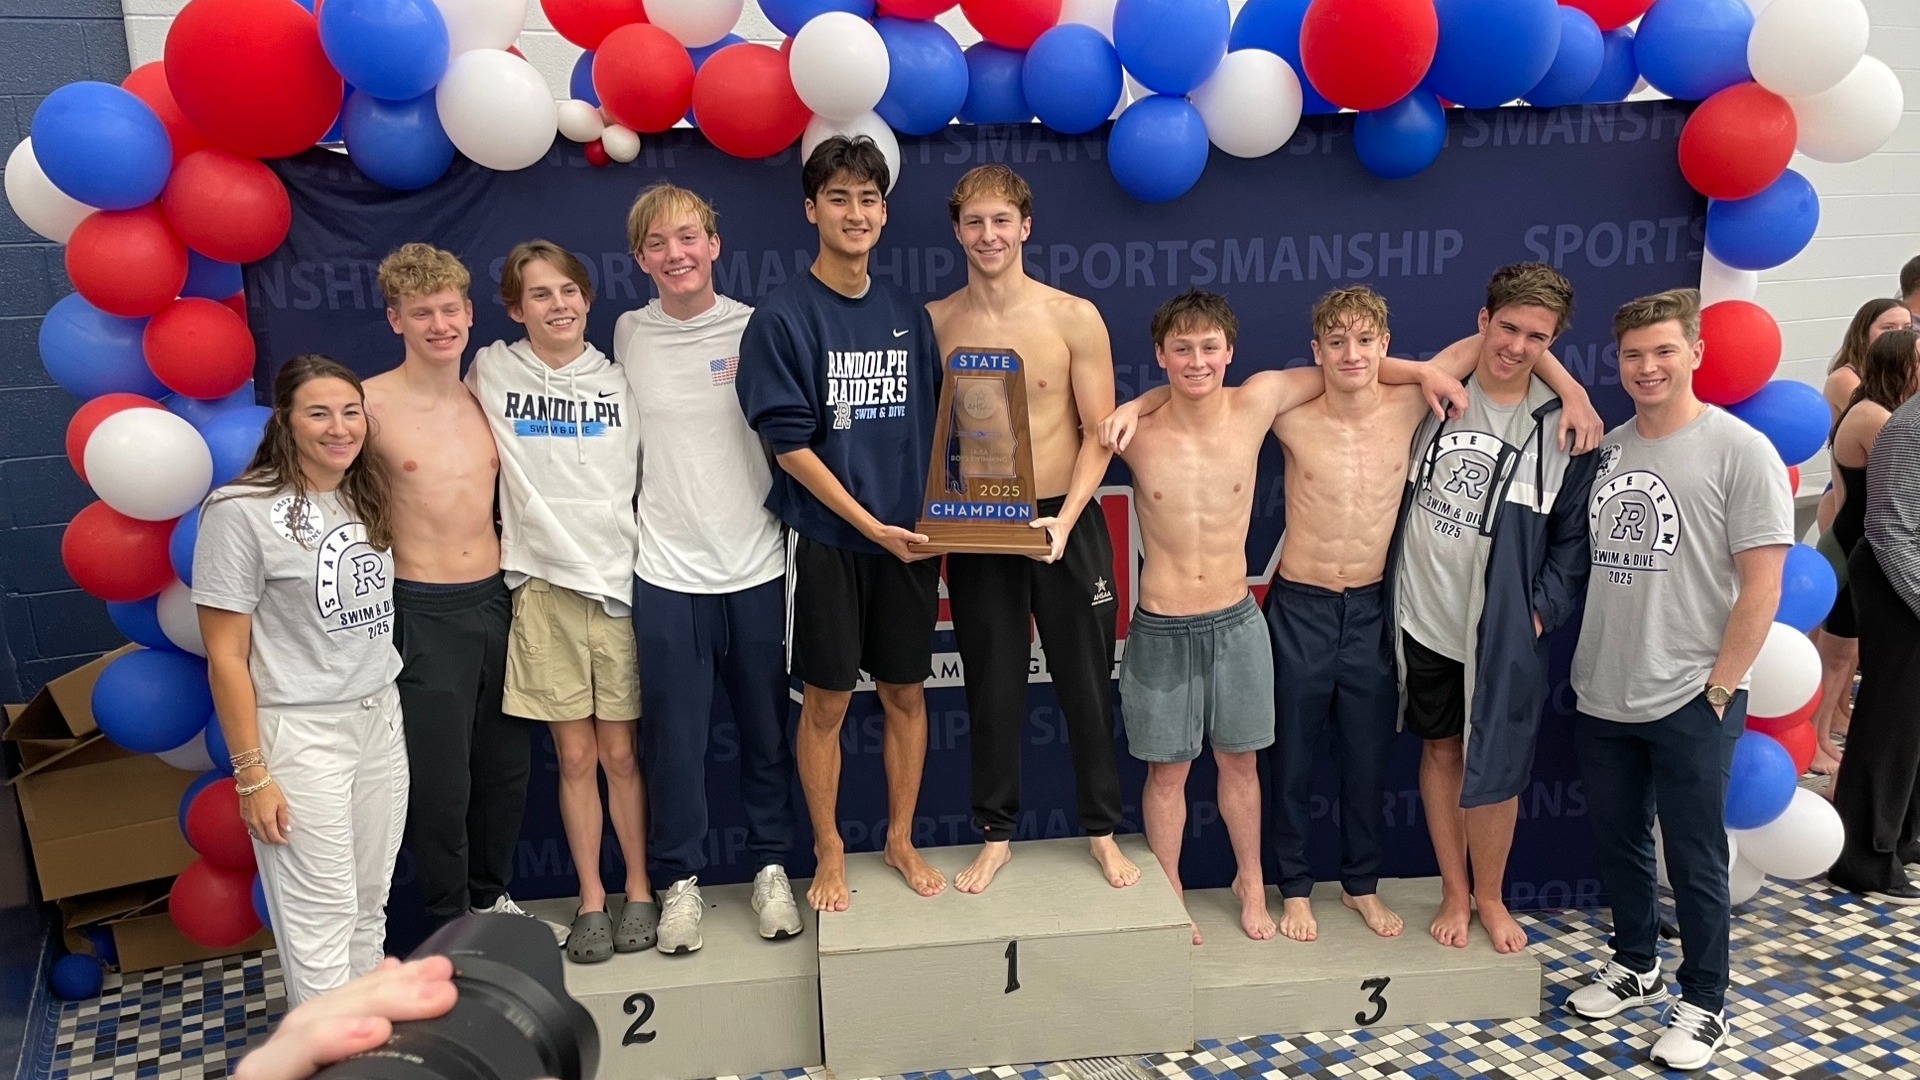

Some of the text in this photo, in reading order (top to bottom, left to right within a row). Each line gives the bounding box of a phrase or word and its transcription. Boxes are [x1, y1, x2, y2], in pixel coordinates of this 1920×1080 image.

[1023, 229, 1463, 289] SPORTSMANSHIP
[827, 350, 908, 379] RANDOLPH
[959, 355, 1010, 369] STATE
[826, 377, 907, 406] RAIDERS
[504, 392, 621, 428] RANDOLPH
[854, 405, 905, 420] SWIM & DIVE
[530, 424, 558, 434] SWIM
[569, 426, 590, 435] DE
[979, 484, 1020, 497] 2025
[273, 497, 291, 512] LAST
[931, 503, 1030, 518] CHAMPION
[1426, 495, 1483, 526] SWIM & DIV
[1648, 481, 1675, 545] TEAM
[1434, 519, 1462, 539] 2025
[1593, 549, 1654, 567] SWIM & DIVE
[1608, 571, 1633, 585] 2025
[340, 606, 375, 626] SWIM
[375, 603, 382, 616] &
[1003, 940, 1020, 994] 1
[1355, 976, 1391, 1027] 3
[622, 993, 656, 1047] 2
